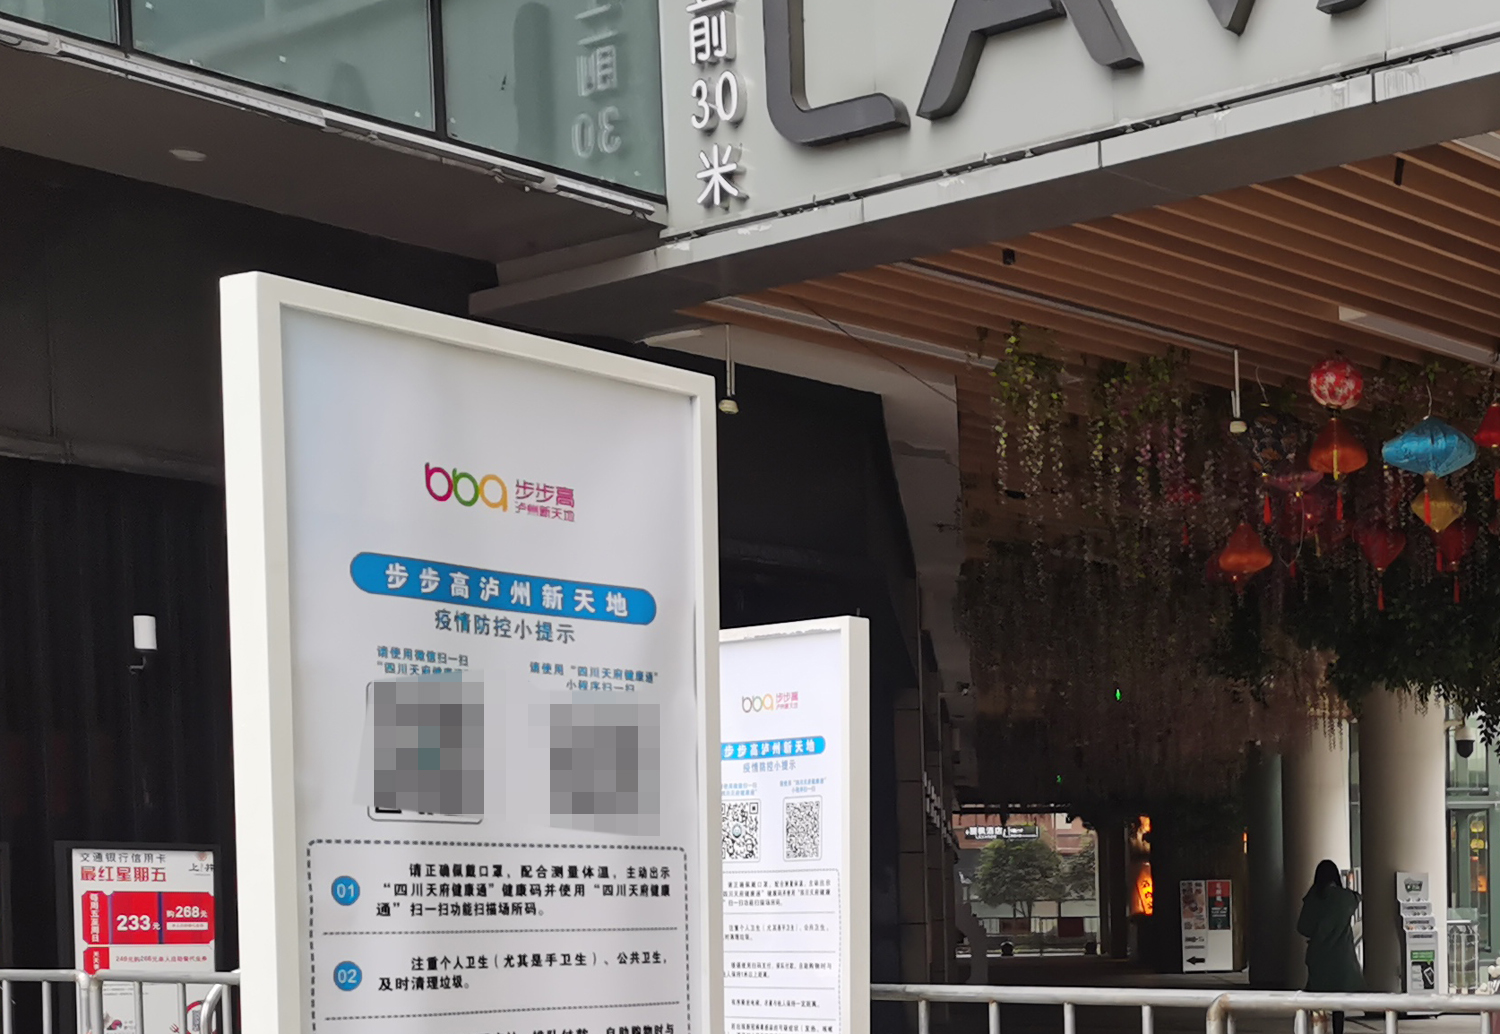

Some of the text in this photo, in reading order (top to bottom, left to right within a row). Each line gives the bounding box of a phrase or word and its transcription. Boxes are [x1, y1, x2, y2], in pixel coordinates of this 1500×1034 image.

[515, 479, 575, 508] 步步高
[514, 501, 576, 523] 泸州新天地
[384, 561, 630, 618] 步步高泸州新天地
[434, 609, 577, 645] 疫情防控小提示
[377, 645, 469, 667] 请使用微信扫一扫
[723, 738, 817, 759] 步步高泸州新天地
[80, 852, 167, 863] 交通银行信用卡
[80, 866, 167, 882] 最红星期五
[336, 884, 356, 899] 01
[166, 906, 208, 919] 购268元
[116, 914, 161, 932] 233元
[337, 969, 358, 984] 02
[378, 975, 471, 992] 及时清理垃圾。
